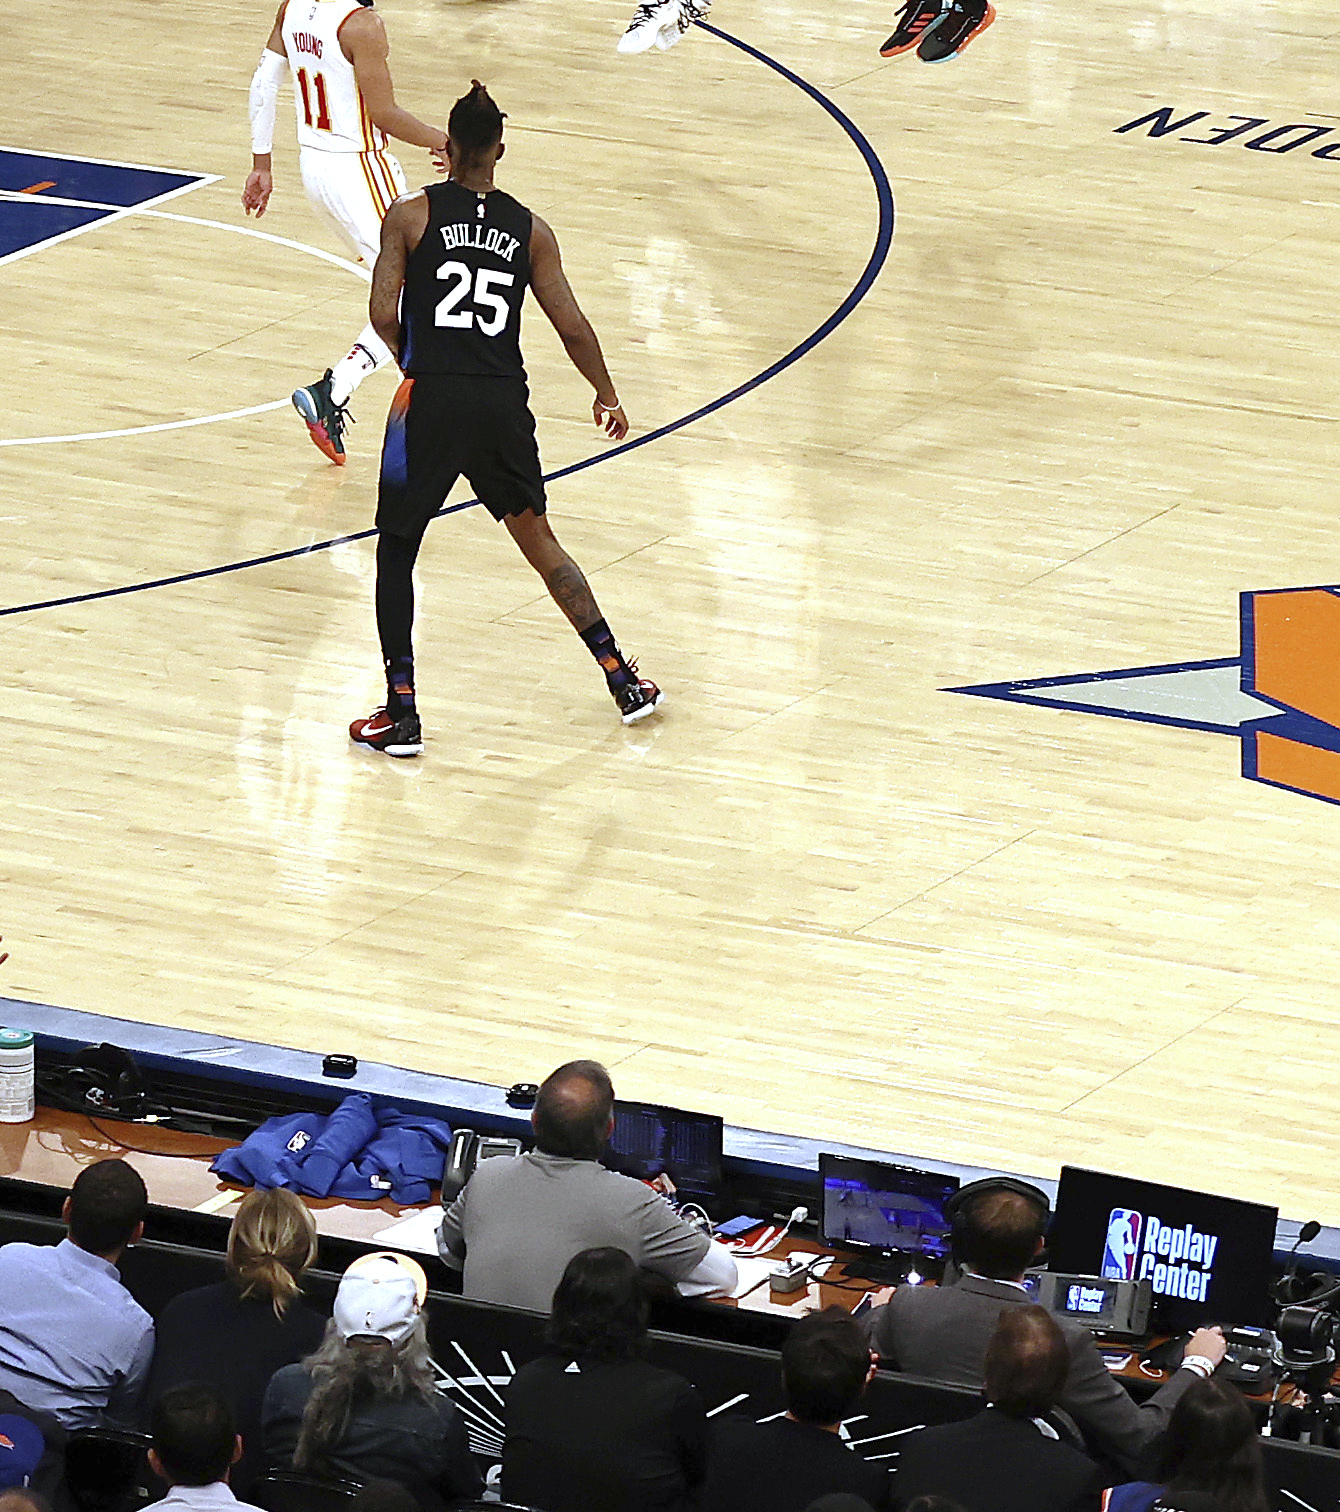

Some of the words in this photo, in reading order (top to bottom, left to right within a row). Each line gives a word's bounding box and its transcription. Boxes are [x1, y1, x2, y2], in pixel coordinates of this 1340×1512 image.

[291, 31, 324, 60] YOUNG
[296, 66, 333, 134] 11
[439, 223, 521, 263] BULLOCK
[434, 259, 516, 338] 25
[1146, 1215, 1219, 1275] Replay
[1141, 1253, 1213, 1303] Center
